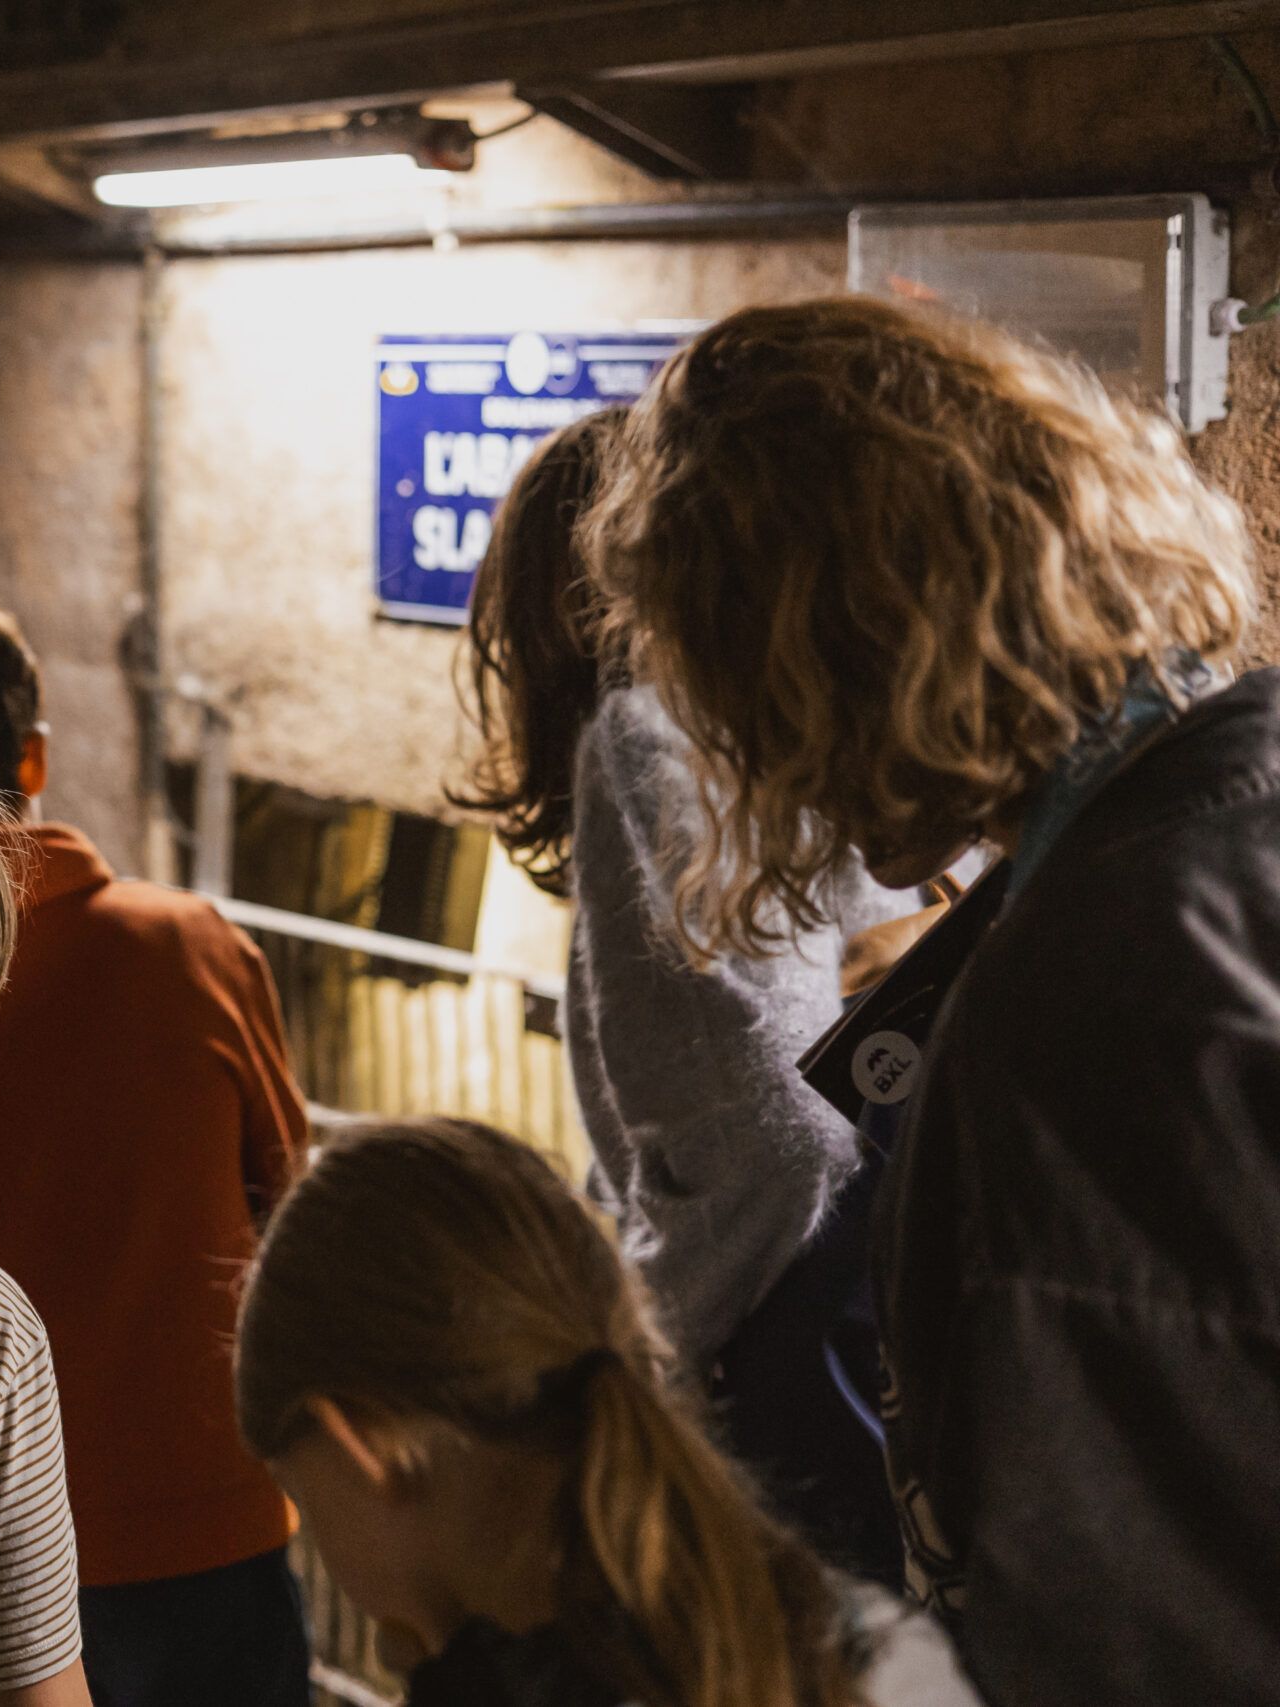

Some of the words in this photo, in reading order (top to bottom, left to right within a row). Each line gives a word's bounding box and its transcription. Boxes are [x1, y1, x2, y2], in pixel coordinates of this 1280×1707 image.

[424, 431, 539, 498] L'ABA
[413, 505, 492, 571] SLA
[874, 1056, 913, 1094] BXL
